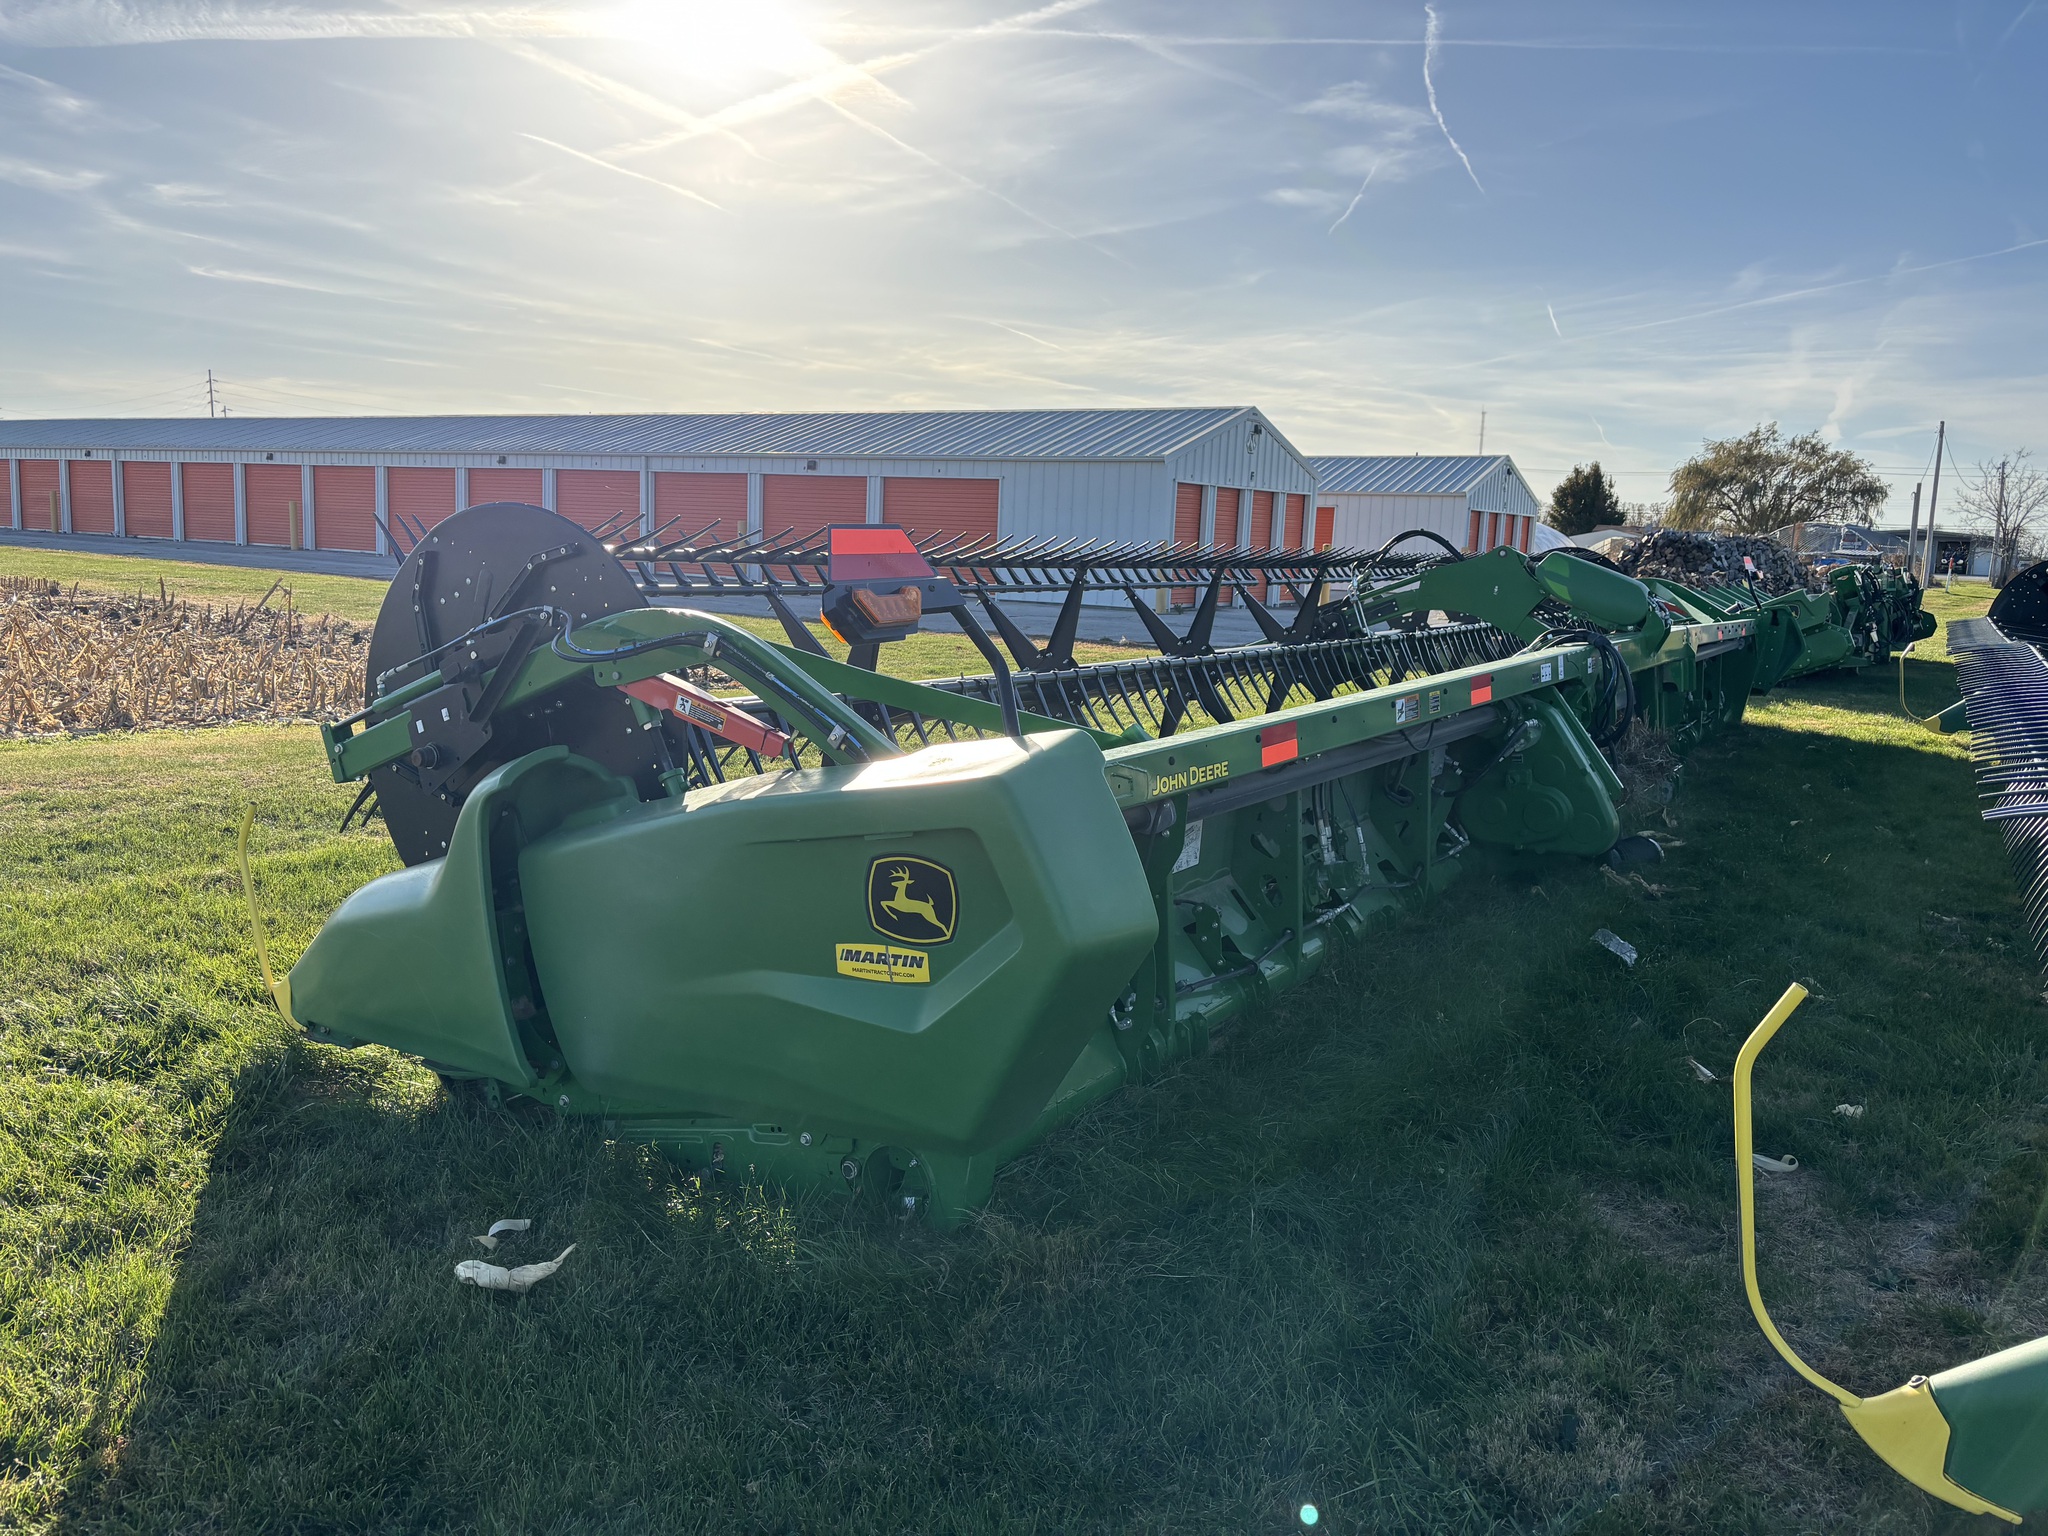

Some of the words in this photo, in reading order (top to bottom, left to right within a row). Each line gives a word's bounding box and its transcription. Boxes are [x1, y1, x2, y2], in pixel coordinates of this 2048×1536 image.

[1250, 471, 1255, 481] F
[1152, 771, 1188, 796] JOHN
[1189, 760, 1229, 786] DEERE
[842, 948, 925, 969] MARTIN
